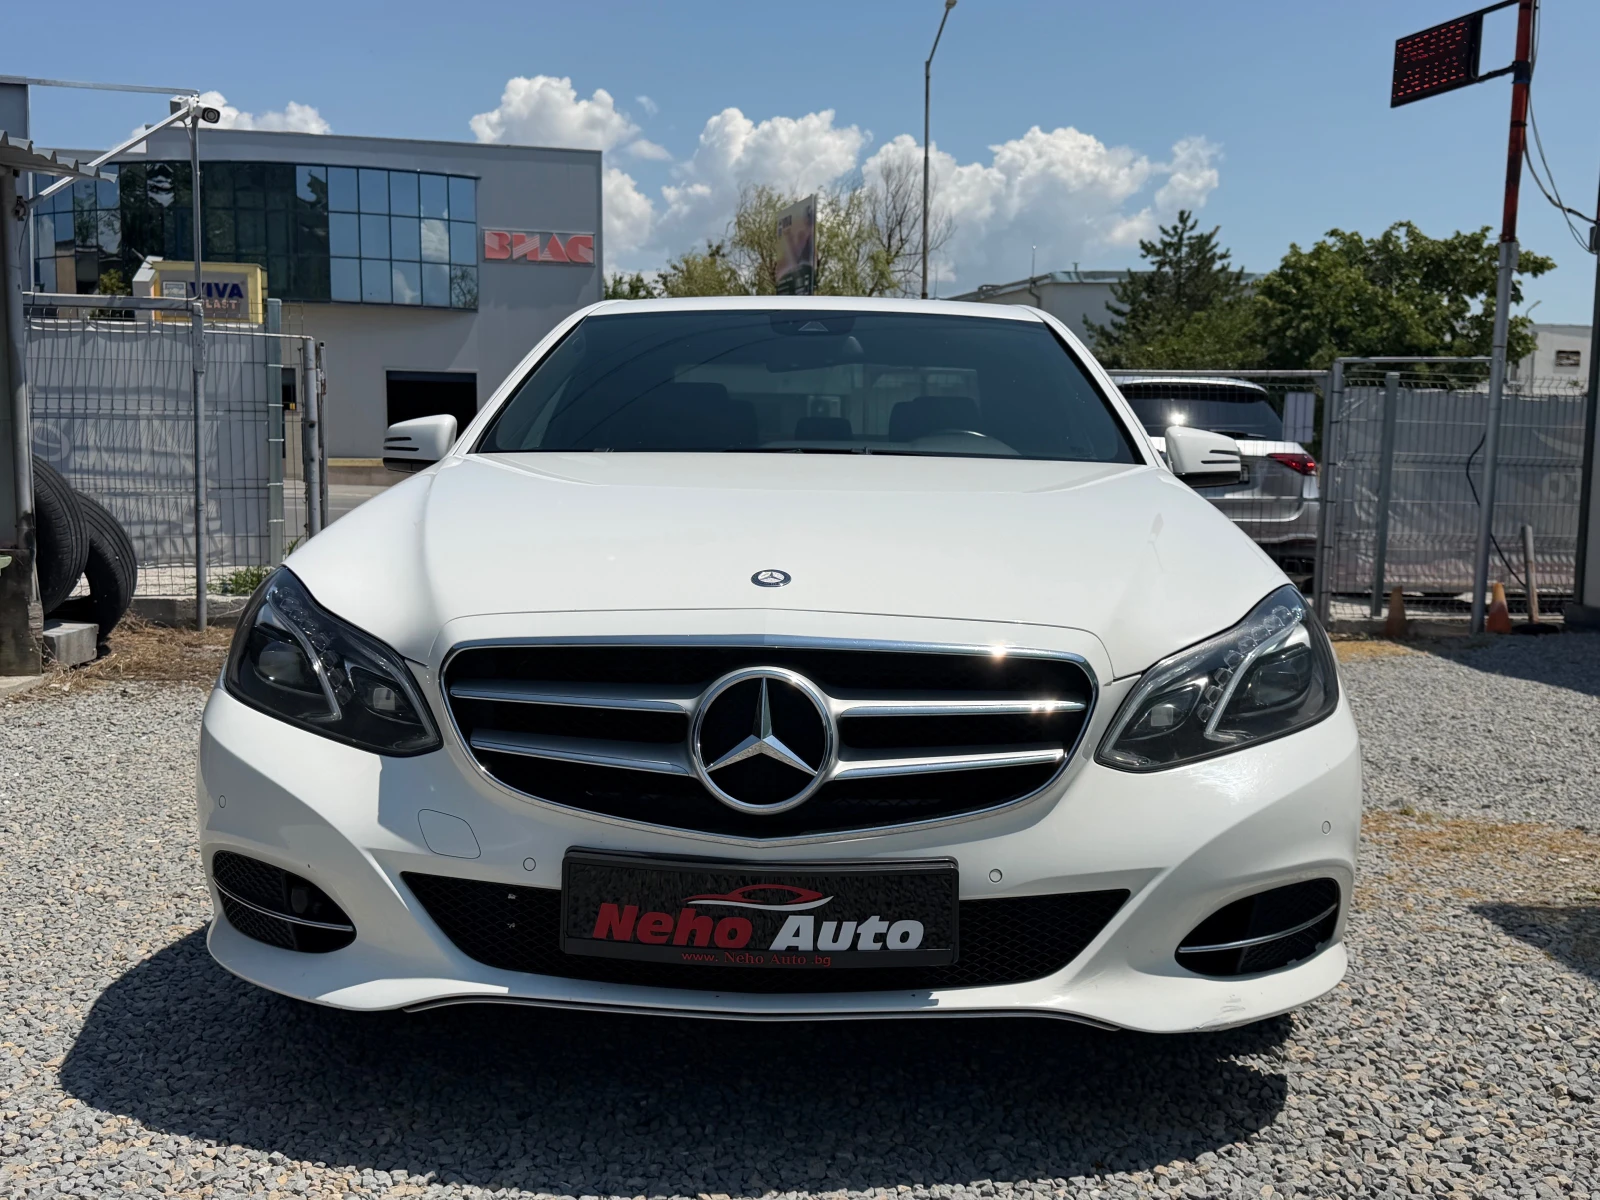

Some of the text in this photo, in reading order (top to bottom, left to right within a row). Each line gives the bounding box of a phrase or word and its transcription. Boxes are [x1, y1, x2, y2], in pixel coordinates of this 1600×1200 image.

[190, 282, 244, 299] VIVA
[201, 299, 238, 310] LAST
[592, 903, 924, 951] Neho Auto
[724, 952, 764, 965] Neho
[769, 954, 807, 966] Auto
